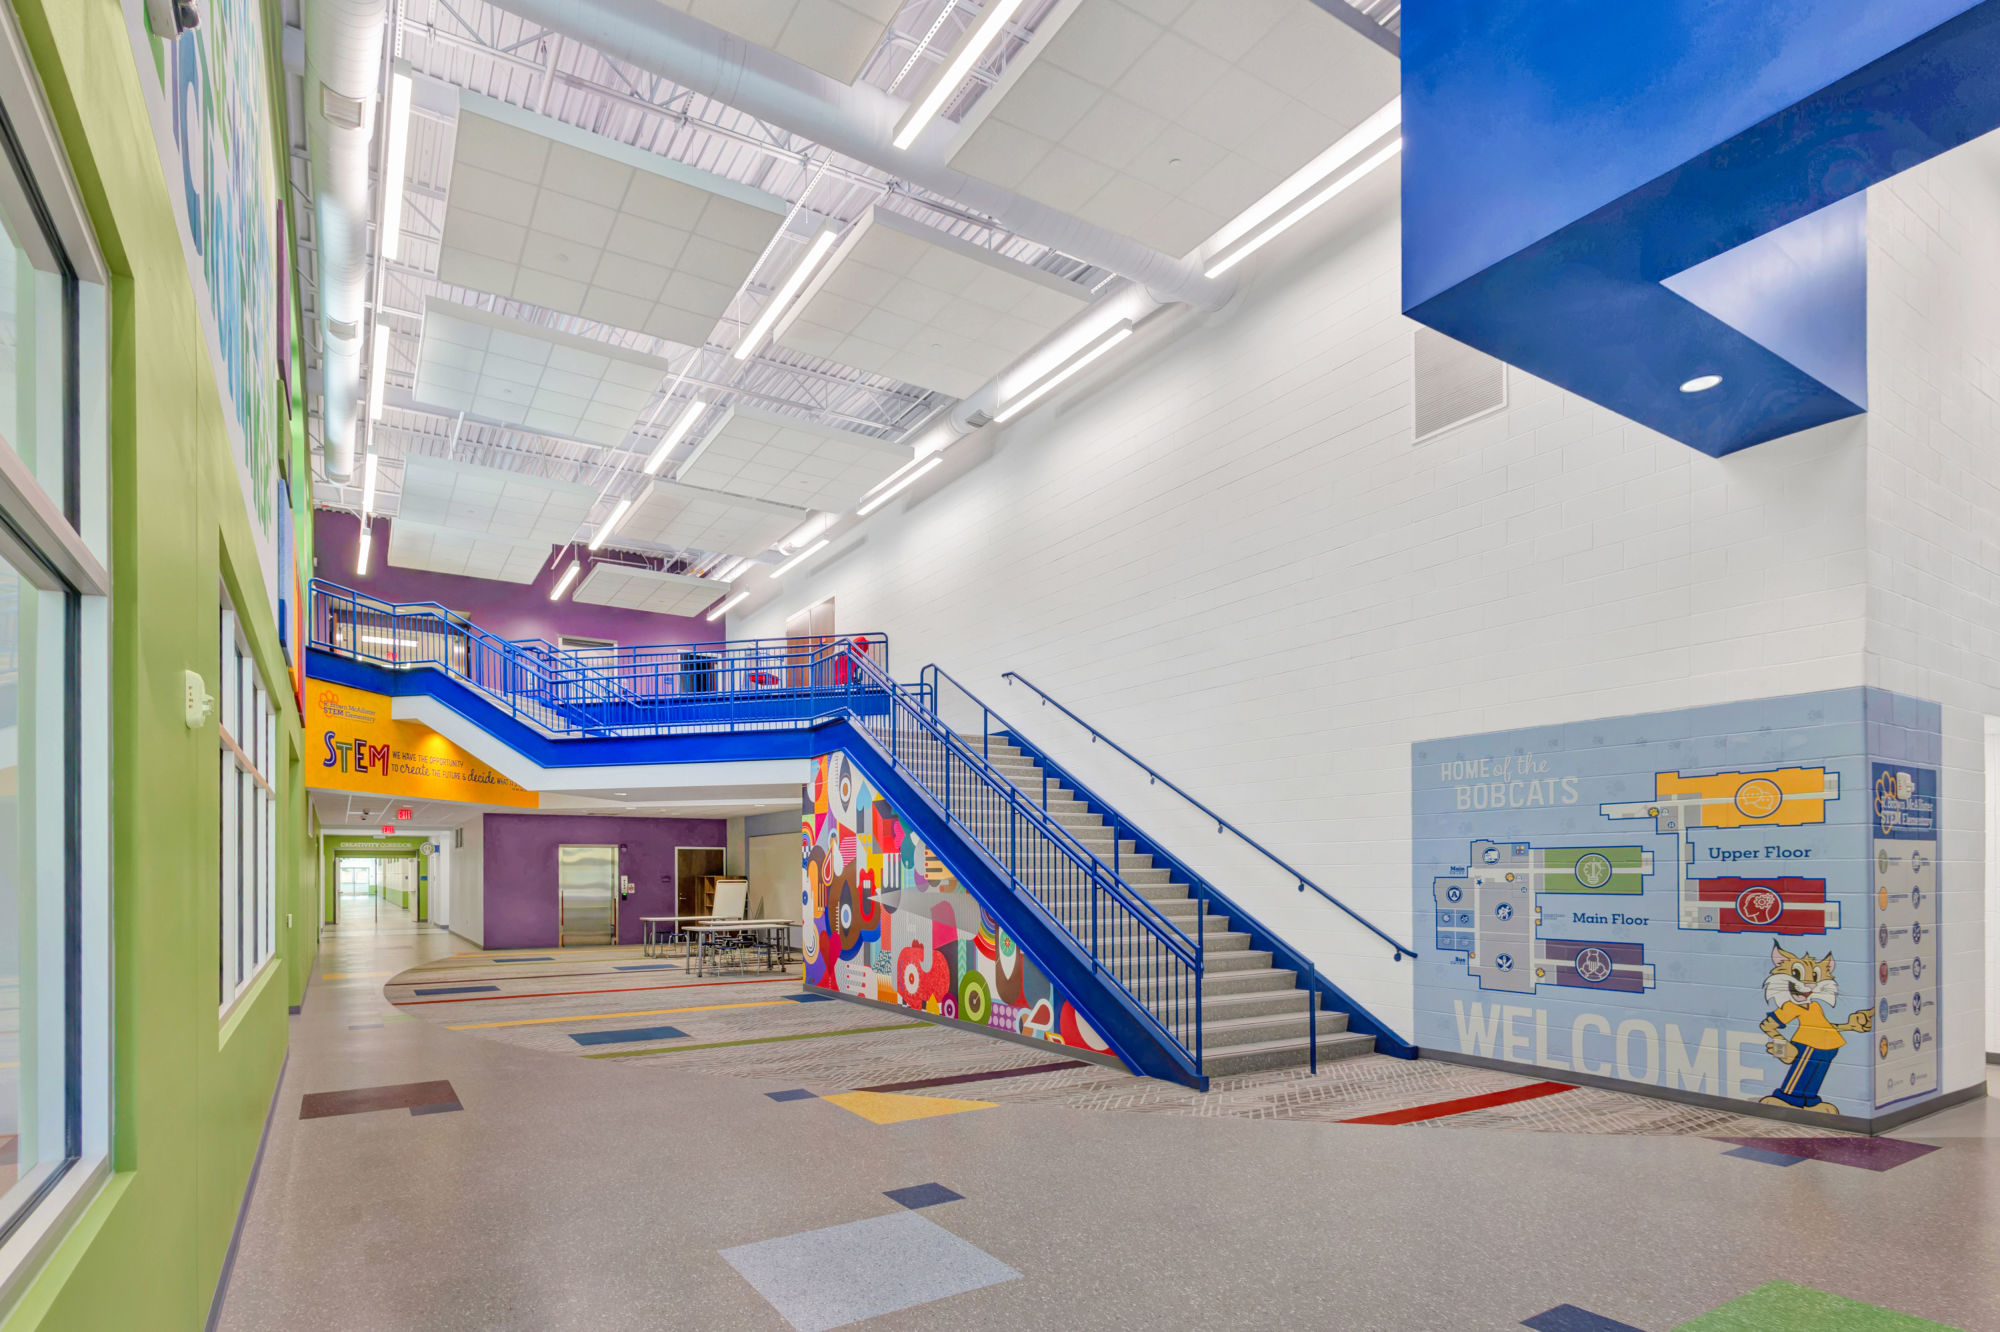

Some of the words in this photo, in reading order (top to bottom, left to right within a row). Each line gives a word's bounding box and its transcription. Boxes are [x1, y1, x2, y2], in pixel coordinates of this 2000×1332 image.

[324, 707, 344, 716] STEM
[323, 730, 390, 776] STEM
[393, 751, 400, 759] WE
[402, 752, 416, 761] HAVE
[418, 755, 428, 763] THE
[429, 756, 464, 768] OPPORTUNITY
[392, 764, 398, 772] TO
[400, 764, 430, 776] create
[431, 768, 441, 777] THE
[442, 770, 460, 780] FUTURE
[467, 768, 496, 784] decide
[1440, 758, 1490, 781] HOME
[1493, 756, 1512, 783] of
[1517, 752, 1550, 775] the
[1456, 775, 1579, 810] BOBCATS
[398, 810, 411, 820] EXIT
[1708, 847, 1760, 862] Upper
[1765, 846, 1812, 858] Floor
[1572, 912, 1608, 924] Main
[1611, 913, 1650, 926] Floor
[1453, 999, 1767, 1099] WELCOME
